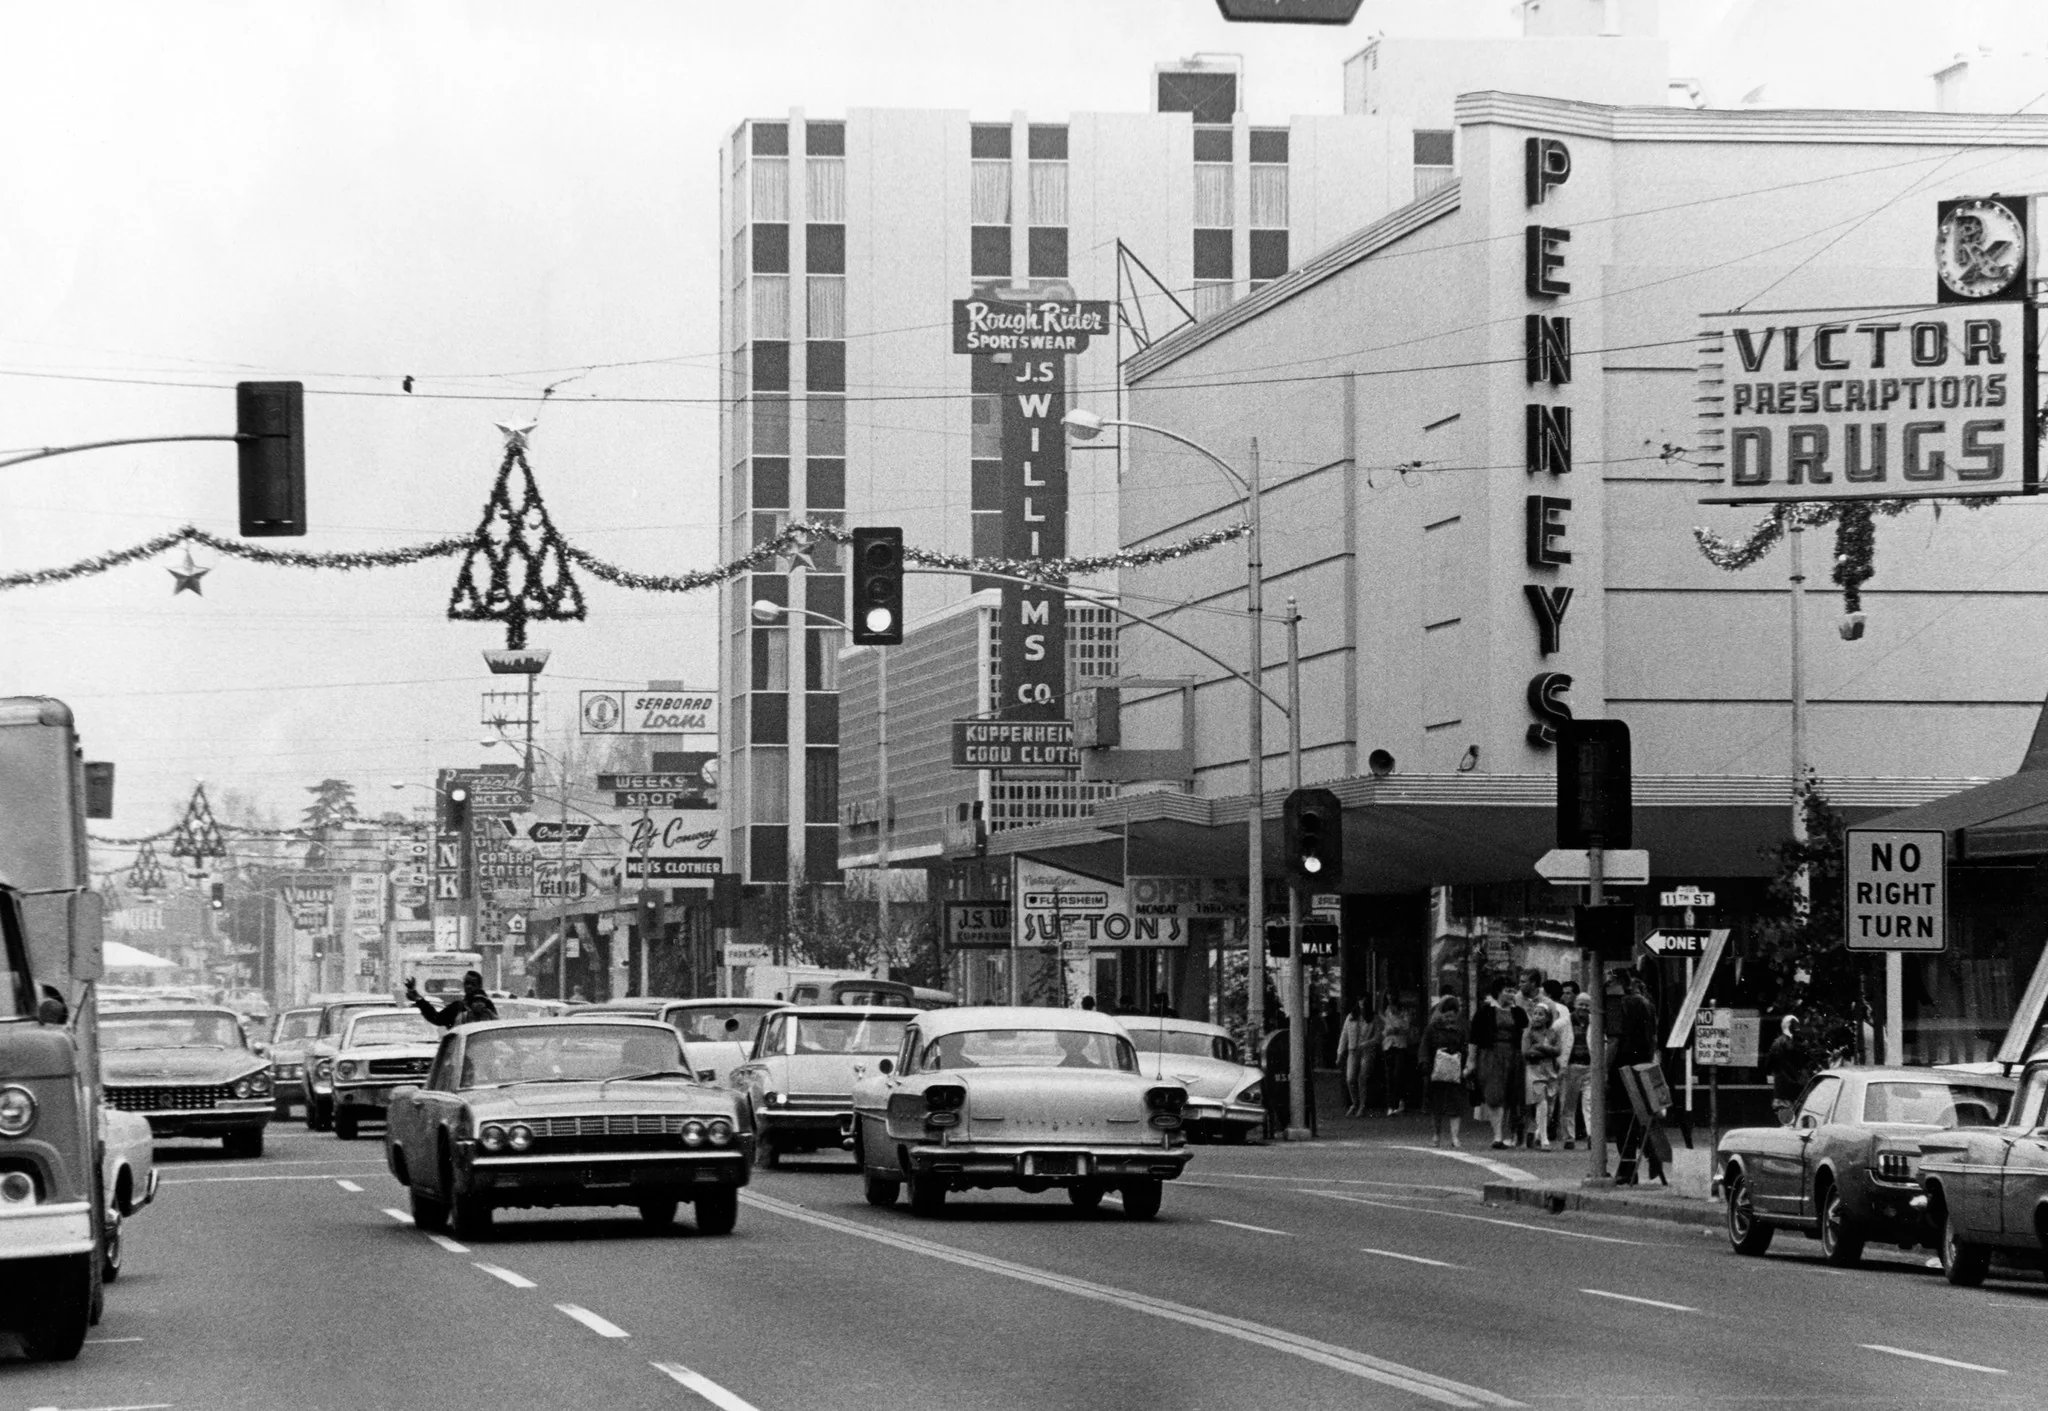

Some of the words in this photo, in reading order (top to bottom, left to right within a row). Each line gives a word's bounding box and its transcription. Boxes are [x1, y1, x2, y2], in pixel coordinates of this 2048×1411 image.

[966, 302, 1041, 334] Rough
[1039, 302, 1103, 333] Rider
[967, 334, 1076, 349] SPORTSWEAR
[1733, 319, 2006, 372] VICTOR
[1733, 374, 2007, 415] PRESCRIPTIONS
[1524, 137, 1574, 748] PENNEYS
[1731, 419, 2006, 487] DRUGS
[1018, 394, 1051, 661] WILLIMS
[1018, 683, 1055, 704] CO.
[635, 698, 713, 710] SEABOARD
[642, 710, 706, 729] Loans
[966, 747, 1011, 763] GOOD
[616, 776, 685, 788] WEEKS
[479, 852, 533, 864] CAMERA
[1872, 843, 1920, 872] NO
[479, 865, 533, 877] CENTER
[664, 862, 720, 874] CLOTHIER
[1694, 895, 1710, 904] ST
[1857, 882, 1935, 905] RIGHT
[1136, 904, 1178, 914] MONDAY
[1858, 915, 1933, 938] TURN
[1301, 943, 1332, 954] WALK
[1666, 937, 1696, 949] ONE
[1697, 1010, 1711, 1024] NO
